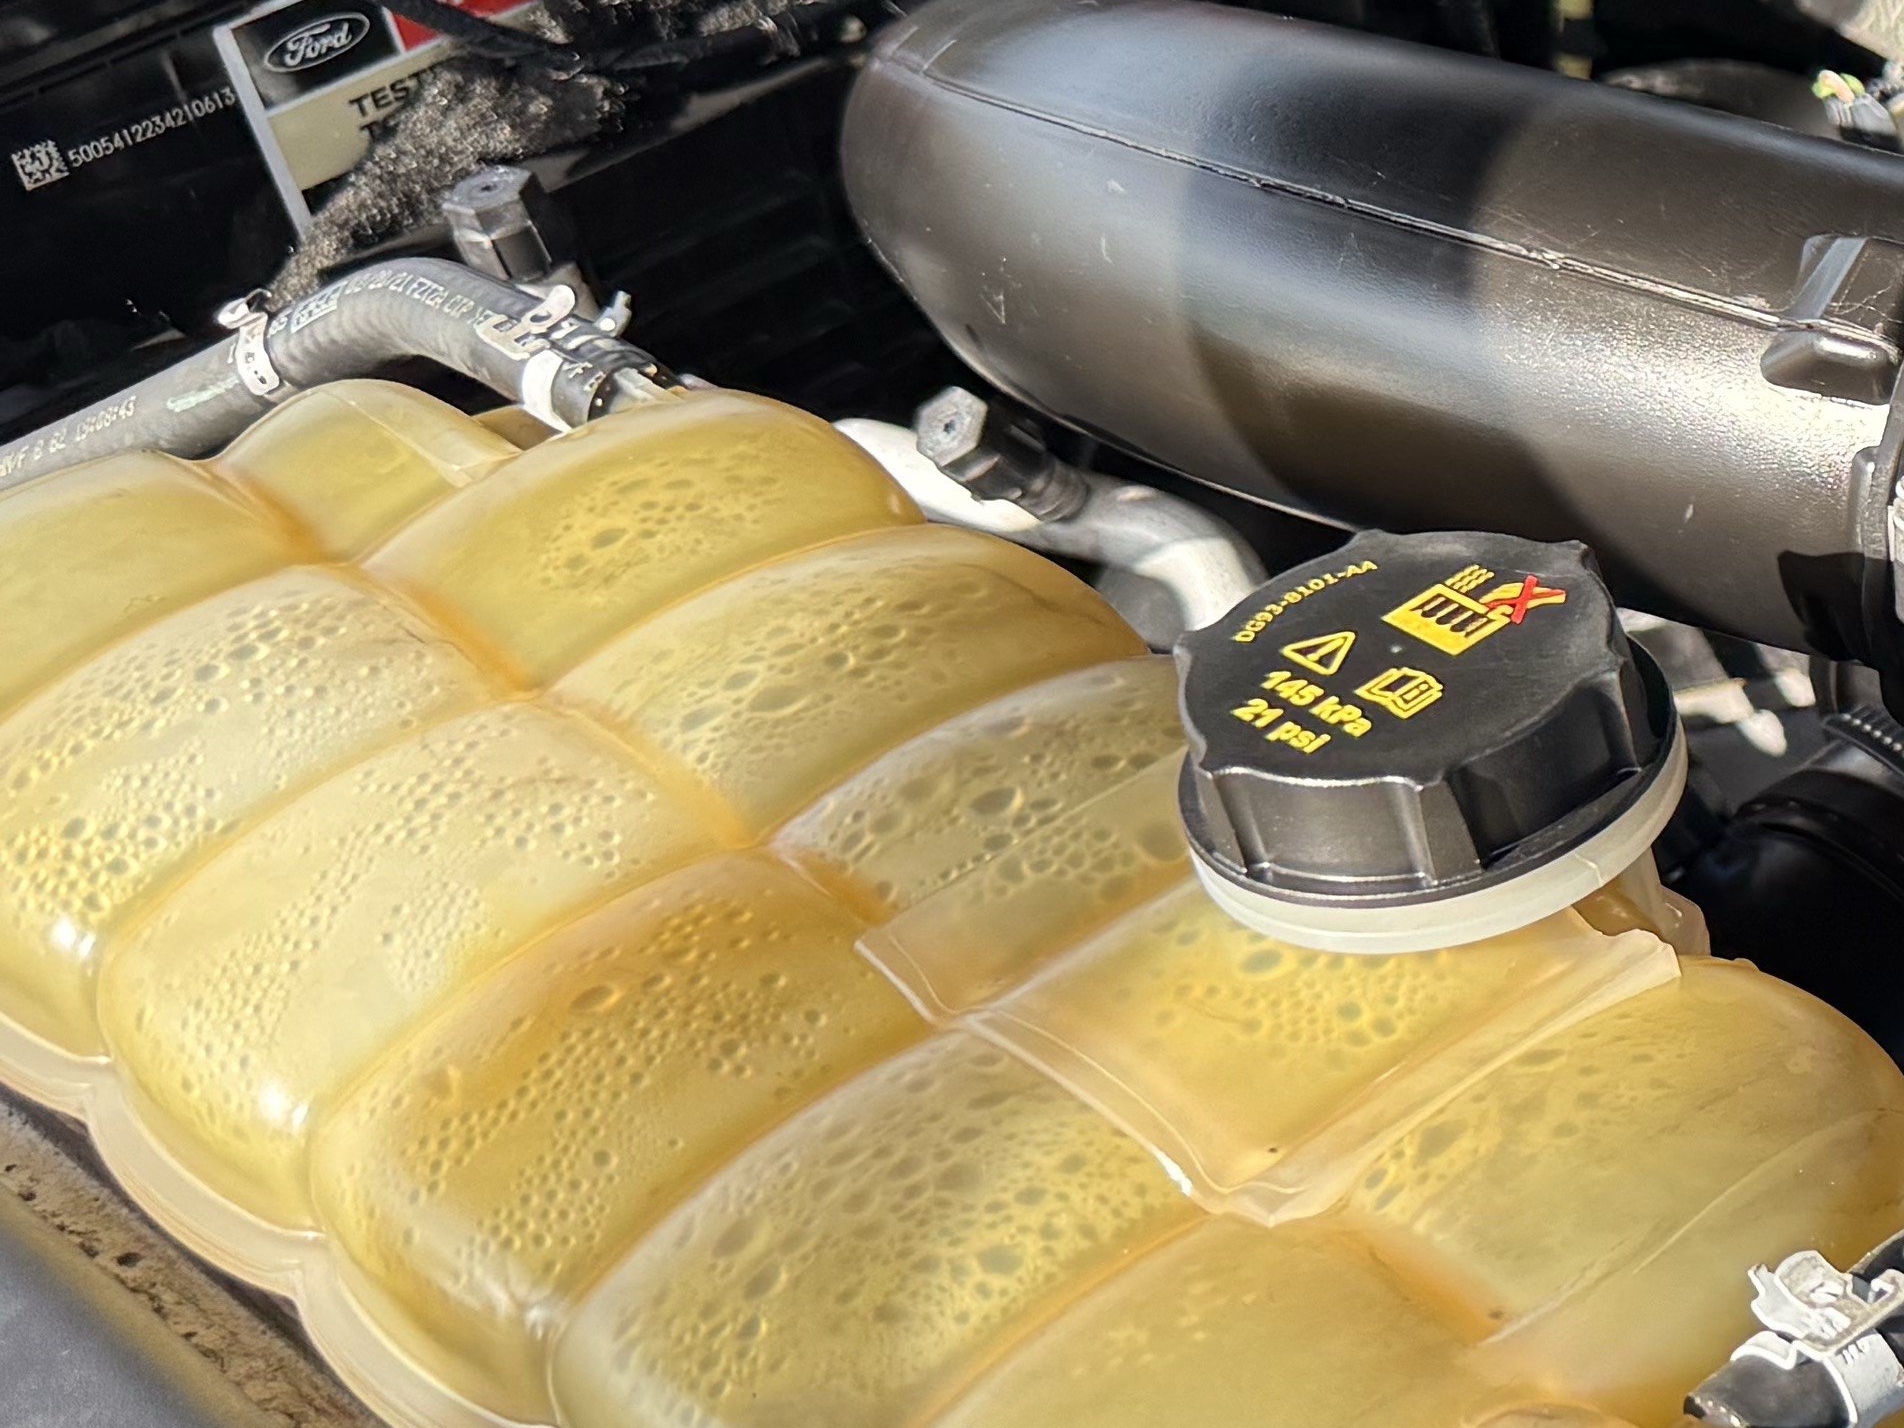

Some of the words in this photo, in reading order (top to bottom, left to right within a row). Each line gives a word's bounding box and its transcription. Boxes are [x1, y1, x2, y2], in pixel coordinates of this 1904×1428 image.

[284, 21, 352, 67] Ford
[1230, 698, 1285, 728] 21
[1264, 721, 1332, 755] psi
[1260, 670, 1325, 706] 145
[1307, 695, 1372, 738] kPa
